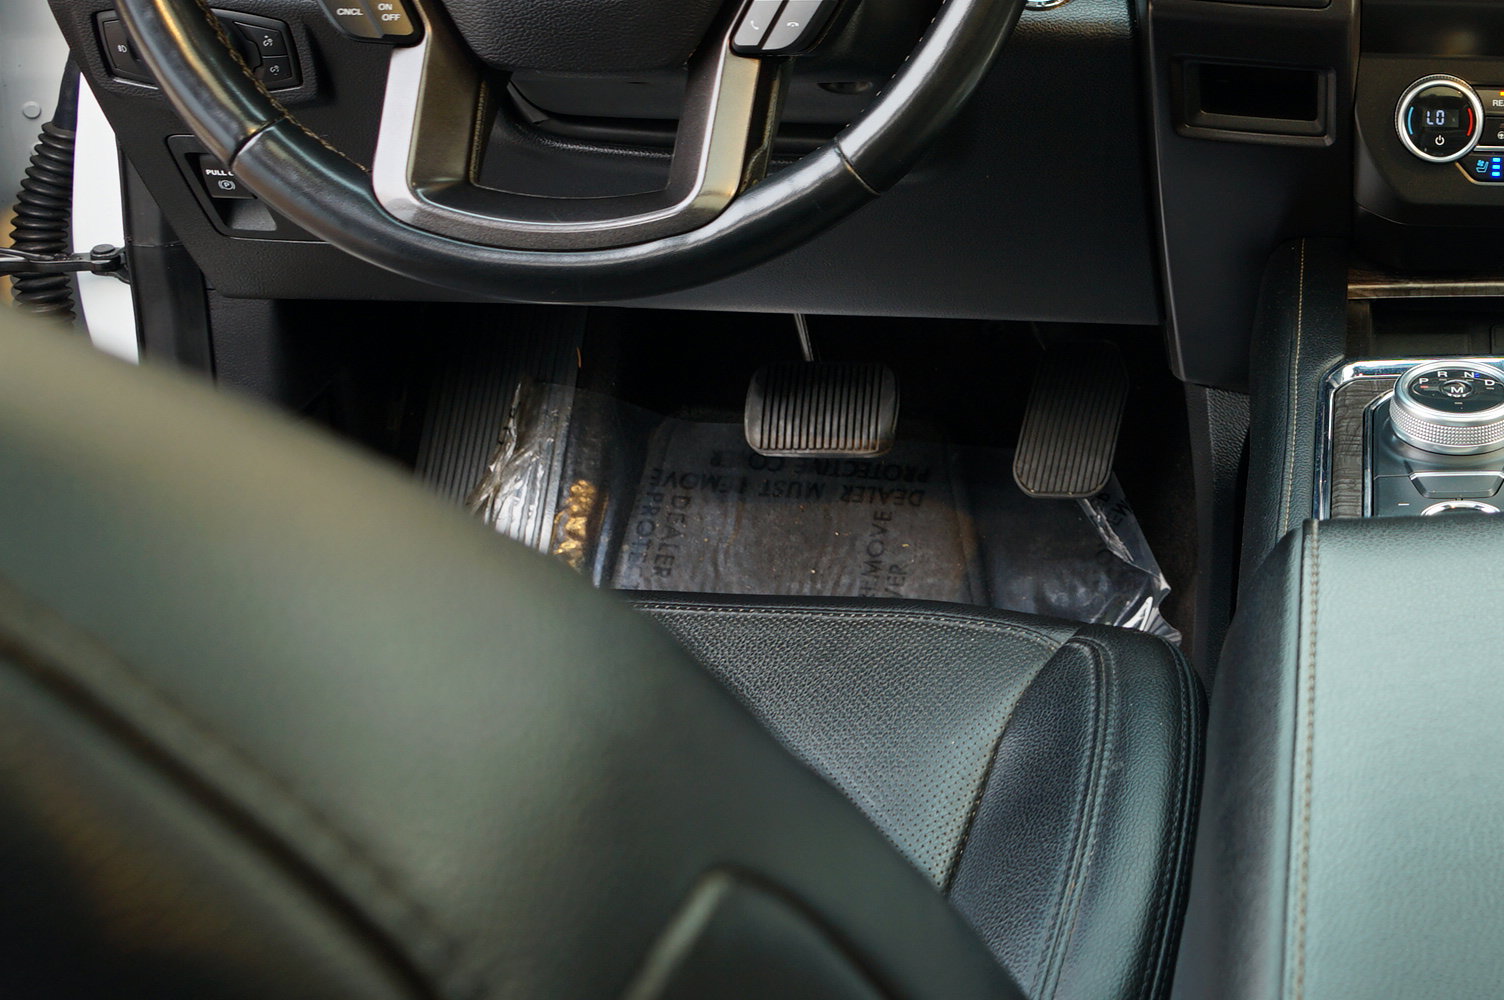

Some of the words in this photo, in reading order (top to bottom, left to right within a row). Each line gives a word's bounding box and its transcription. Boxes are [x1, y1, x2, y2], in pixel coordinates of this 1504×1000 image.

[336, 7, 364, 17] CNCL
[377, 2, 393, 12] ON
[381, 13, 401, 22] OFF
[205, 168, 228, 177] PULL
[760, 480, 826, 500] MUST
[842, 484, 925, 508] DEALER
[652, 495, 692, 579] DEALER
